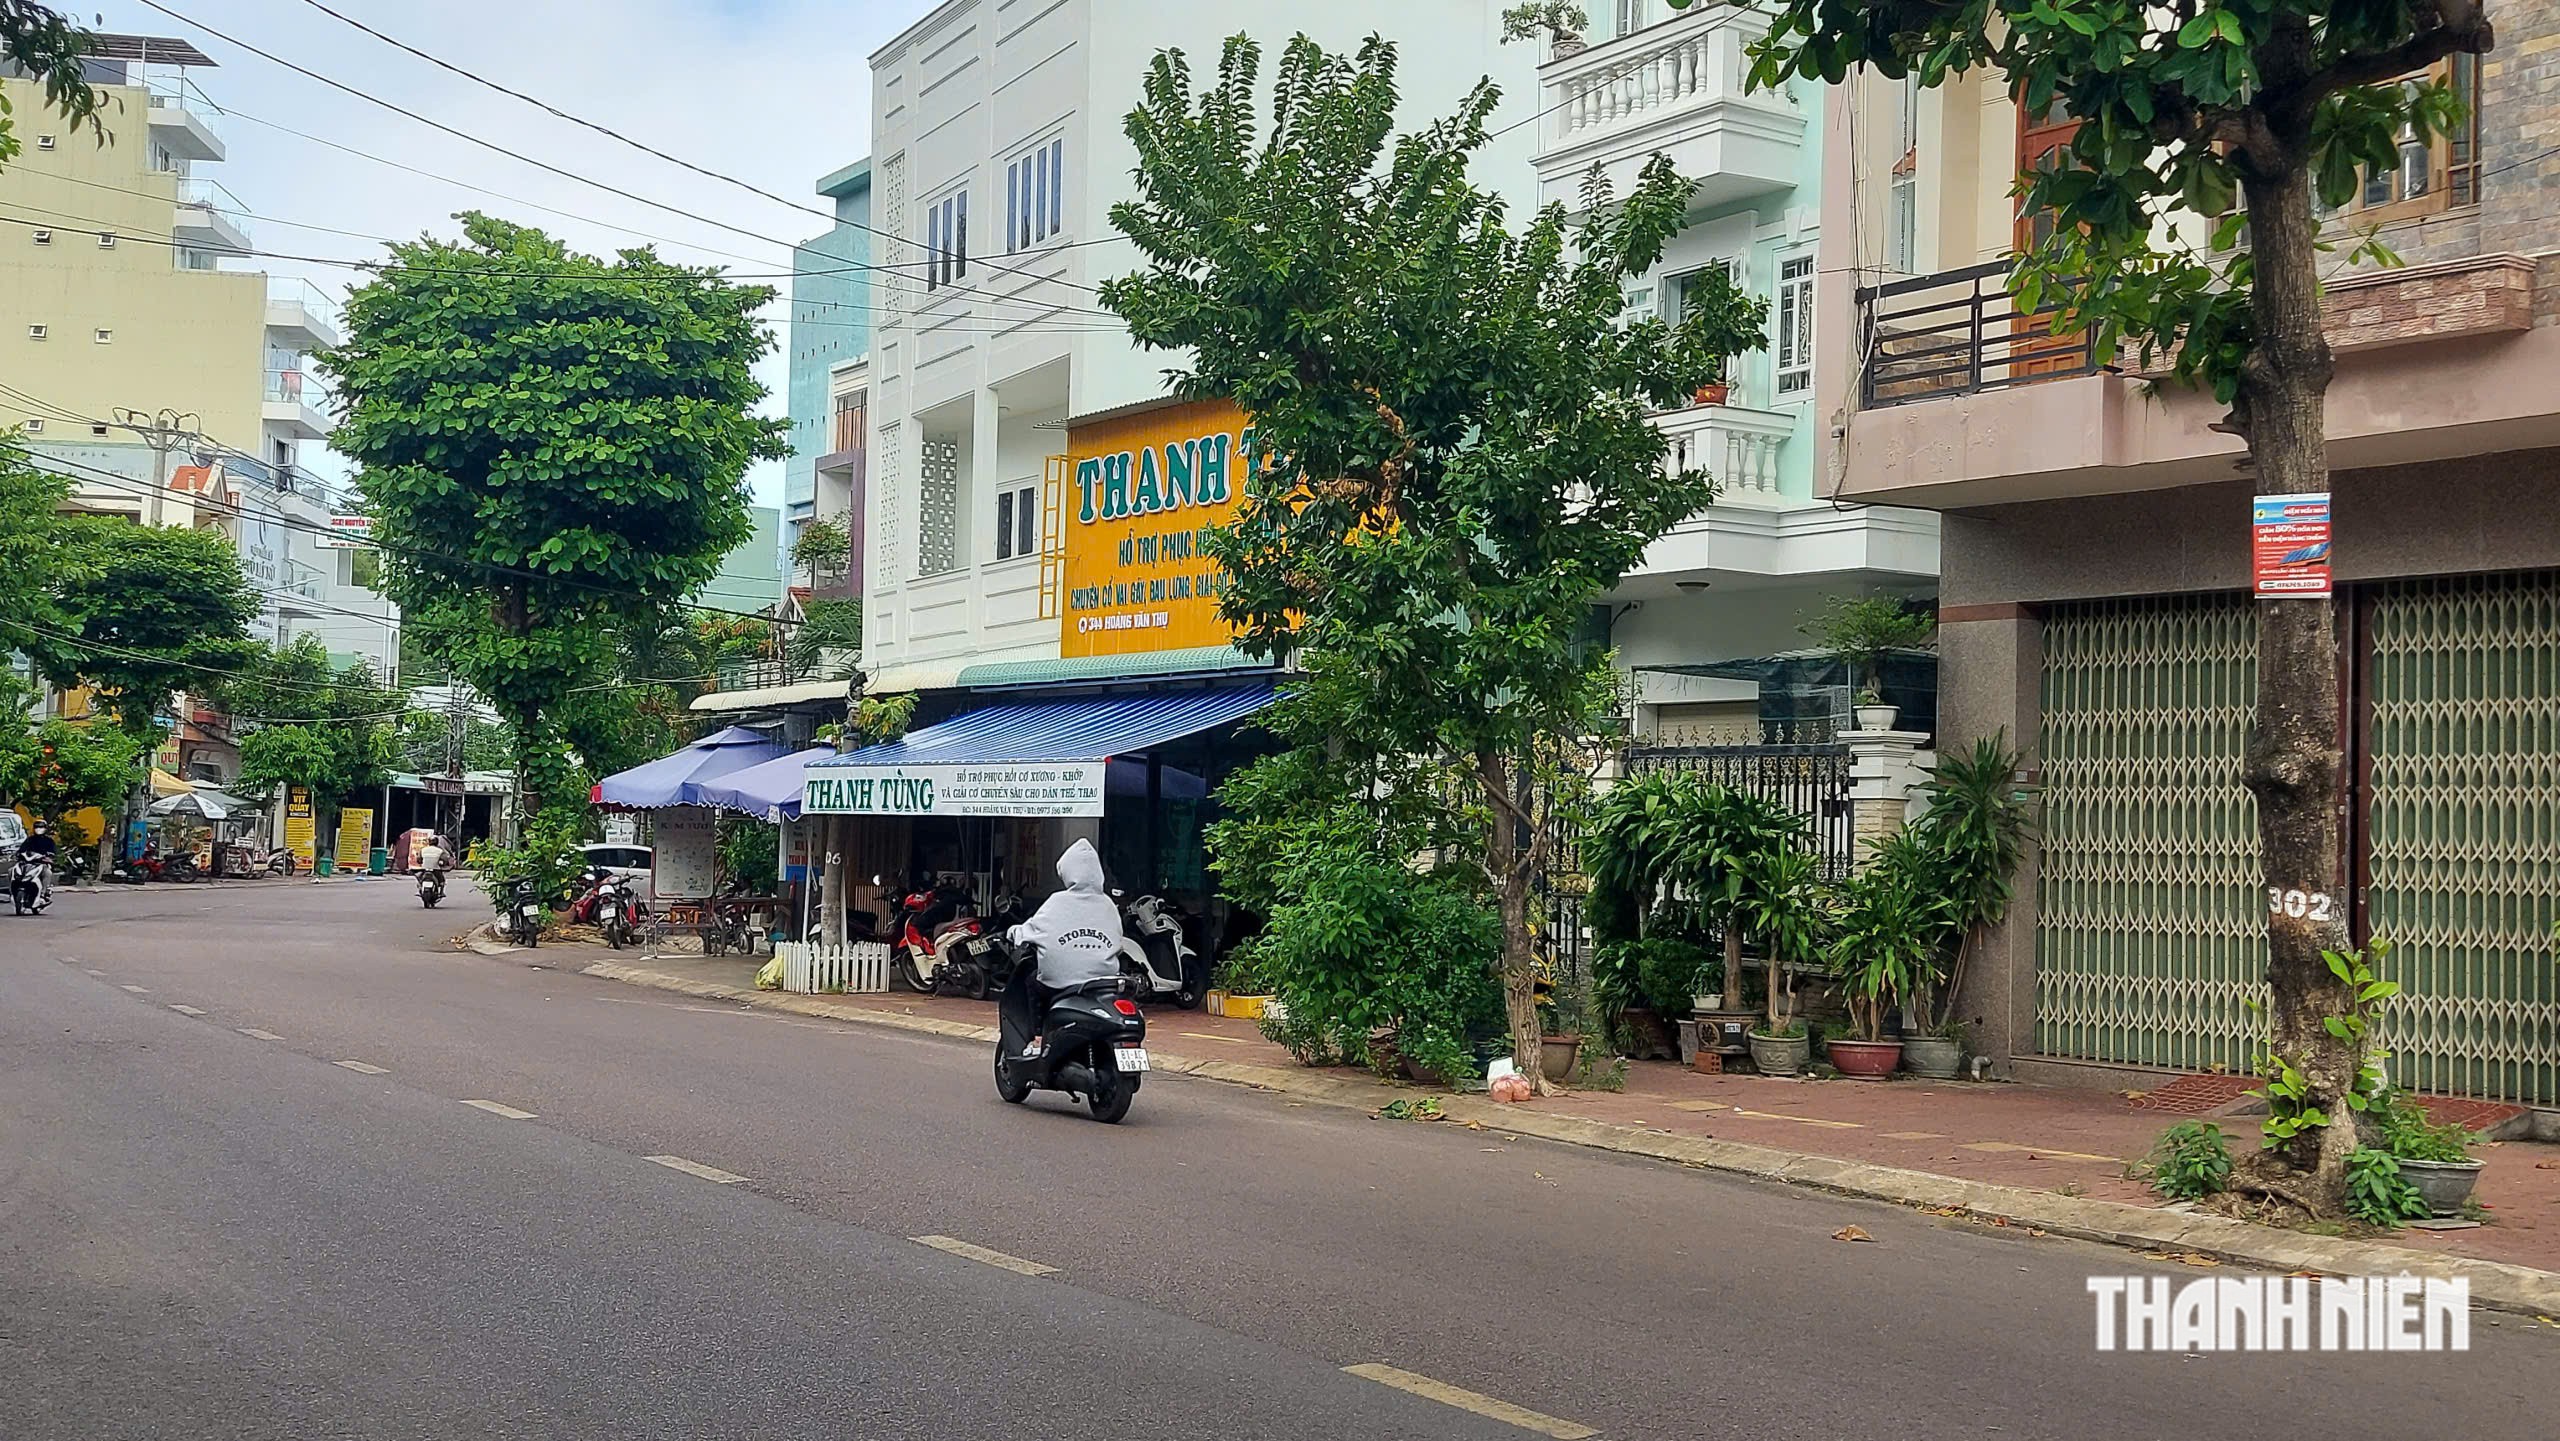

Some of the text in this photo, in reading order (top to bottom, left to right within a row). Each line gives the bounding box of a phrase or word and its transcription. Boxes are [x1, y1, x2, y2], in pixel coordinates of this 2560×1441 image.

[1076, 432, 1232, 524] THANH
[1137, 531, 1160, 569] TRỢ
[1161, 529, 1194, 567] PHỤC
[1116, 582, 1129, 607] VAI
[1088, 611, 1169, 631] 344 HOÀNG VĂN THỤ
[806, 768, 935, 812] THANH TÙNG
[968, 770, 983, 785] TRỢ
[983, 770, 1003, 785] PHỤC
[1062, 768, 1084, 782] KHỚP
[1025, 788, 1041, 799] CHO
[2268, 886, 2331, 921] 302
